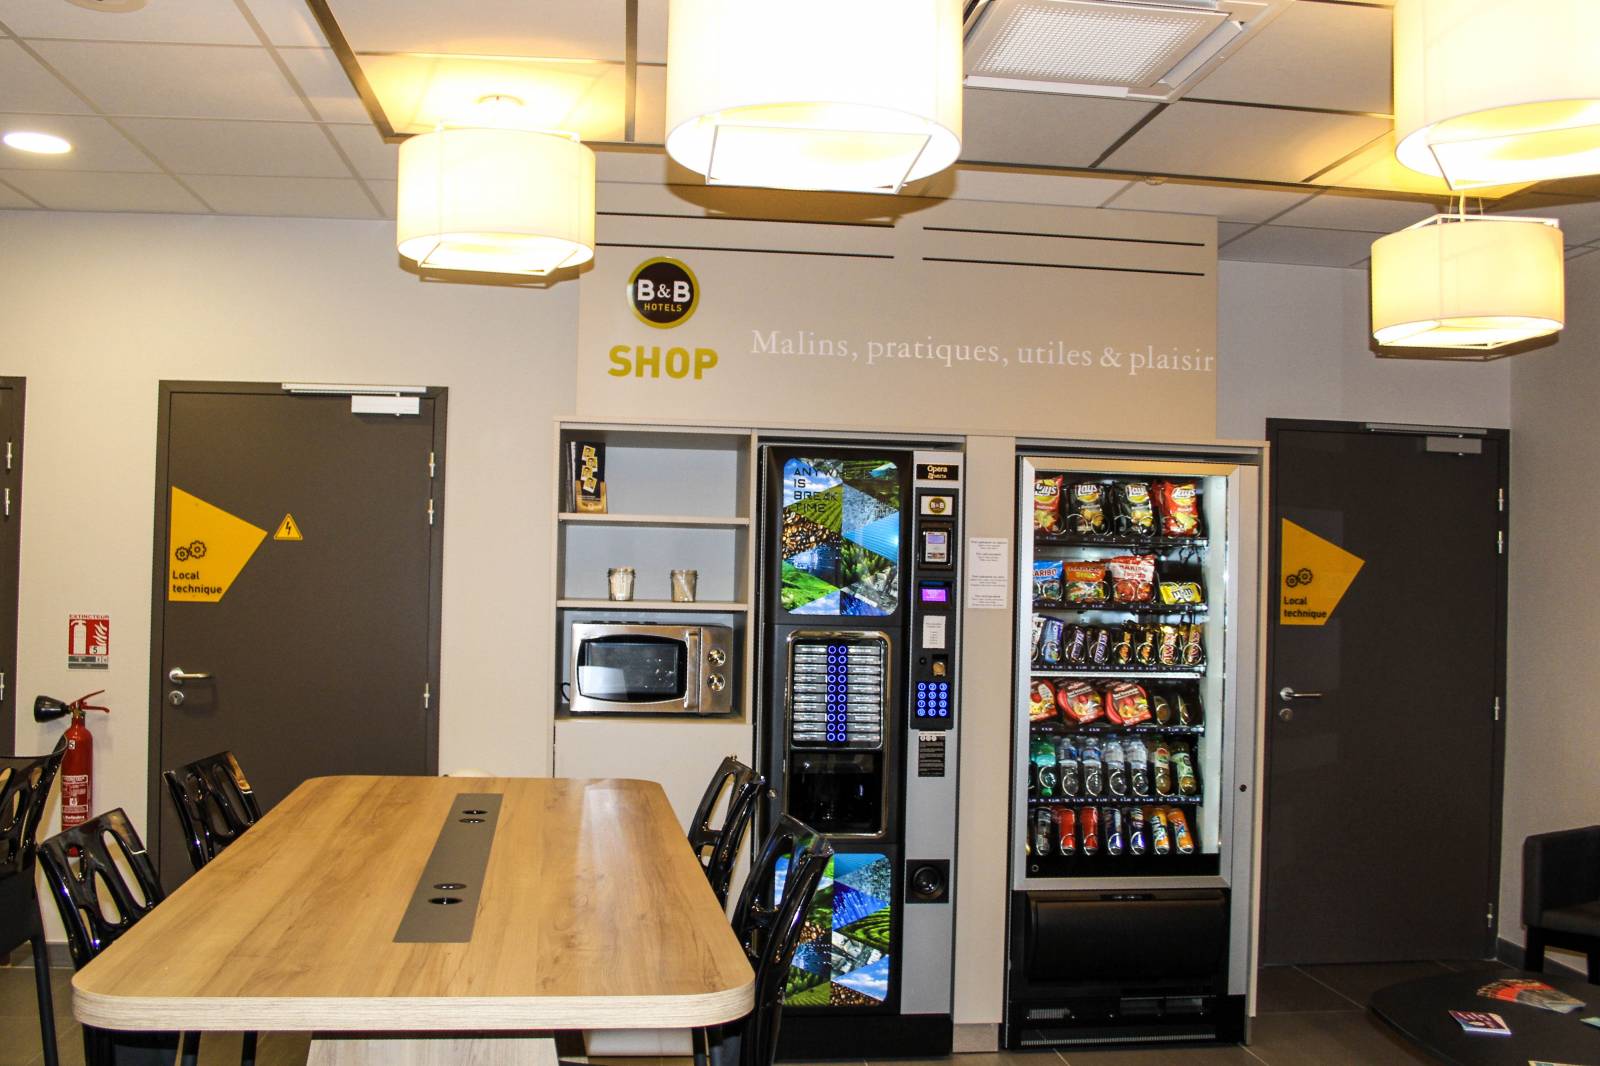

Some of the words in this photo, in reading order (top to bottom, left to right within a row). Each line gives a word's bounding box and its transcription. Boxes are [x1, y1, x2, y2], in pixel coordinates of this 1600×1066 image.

[637, 278, 691, 303] B&B
[643, 303, 683, 312] HOTELS
[751, 329, 858, 362] Malins,
[866, 336, 1009, 368] pratiques,
[1017, 341, 1092, 367] utiles
[1099, 346, 1122, 368] &
[1128, 345, 1214, 375] plaisir
[607, 344, 719, 380] SHOP
[927, 465, 948, 474] Opera
[793, 479, 806, 488] IS
[793, 491, 837, 502] BREAK
[794, 503, 826, 513] TIME
[172, 570, 200, 580] Local
[172, 584, 223, 595] technique
[1283, 596, 1307, 605] Local
[1283, 609, 1327, 619] technique
